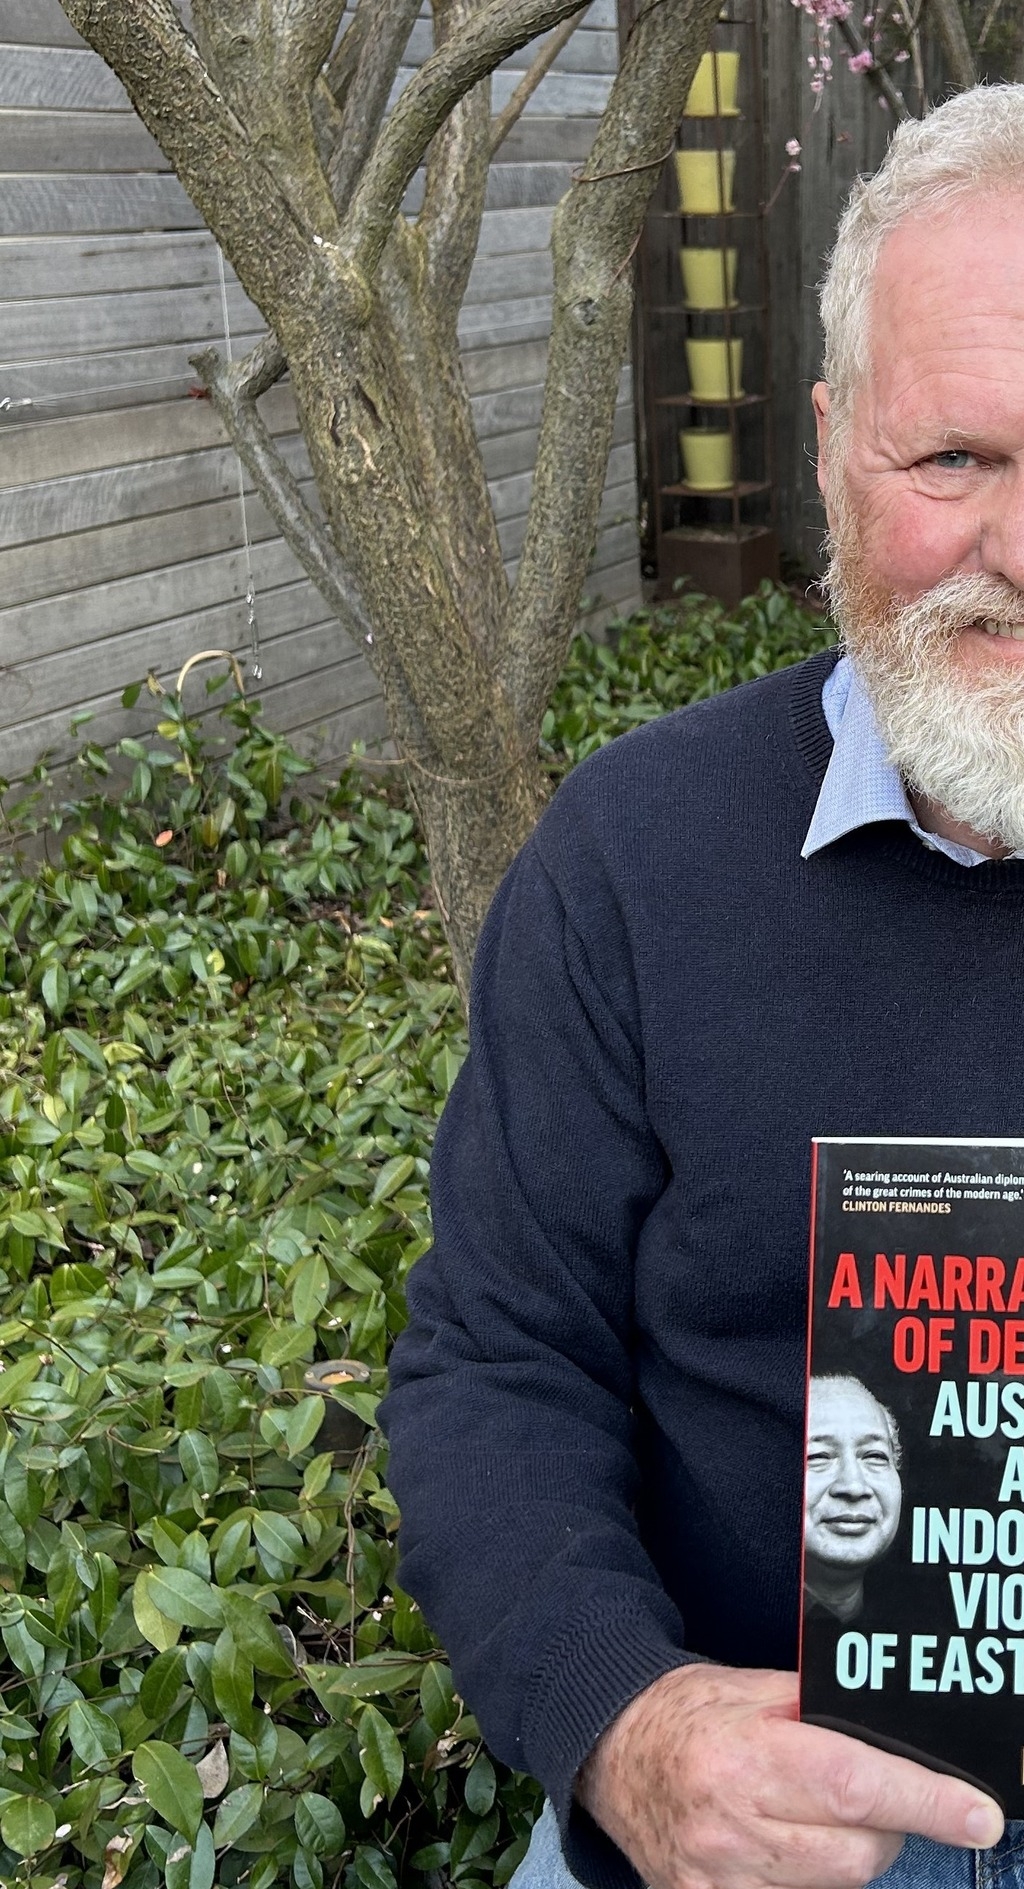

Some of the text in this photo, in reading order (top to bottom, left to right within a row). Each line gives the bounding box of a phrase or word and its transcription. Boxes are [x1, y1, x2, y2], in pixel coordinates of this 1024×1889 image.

[842, 1186, 853, 1196] of
[855, 1185, 871, 1196] the
[872, 1187, 898, 1198] great
[900, 1187, 932, 1198] crimes
[933, 1187, 944, 1198] of
[946, 1187, 962, 1198] the
[964, 1188, 1000, 1199] modern
[855, 1171, 890, 1184] searing
[892, 1173, 929, 1183] account
[932, 1172, 942, 1183] of
[943, 1172, 993, 1184] Australian
[842, 1200, 951, 1214] CLINTON FERNANDES
[828, 1253, 863, 1309] A
[893, 1316, 954, 1374] OF
[836, 1632, 897, 1690] OF
